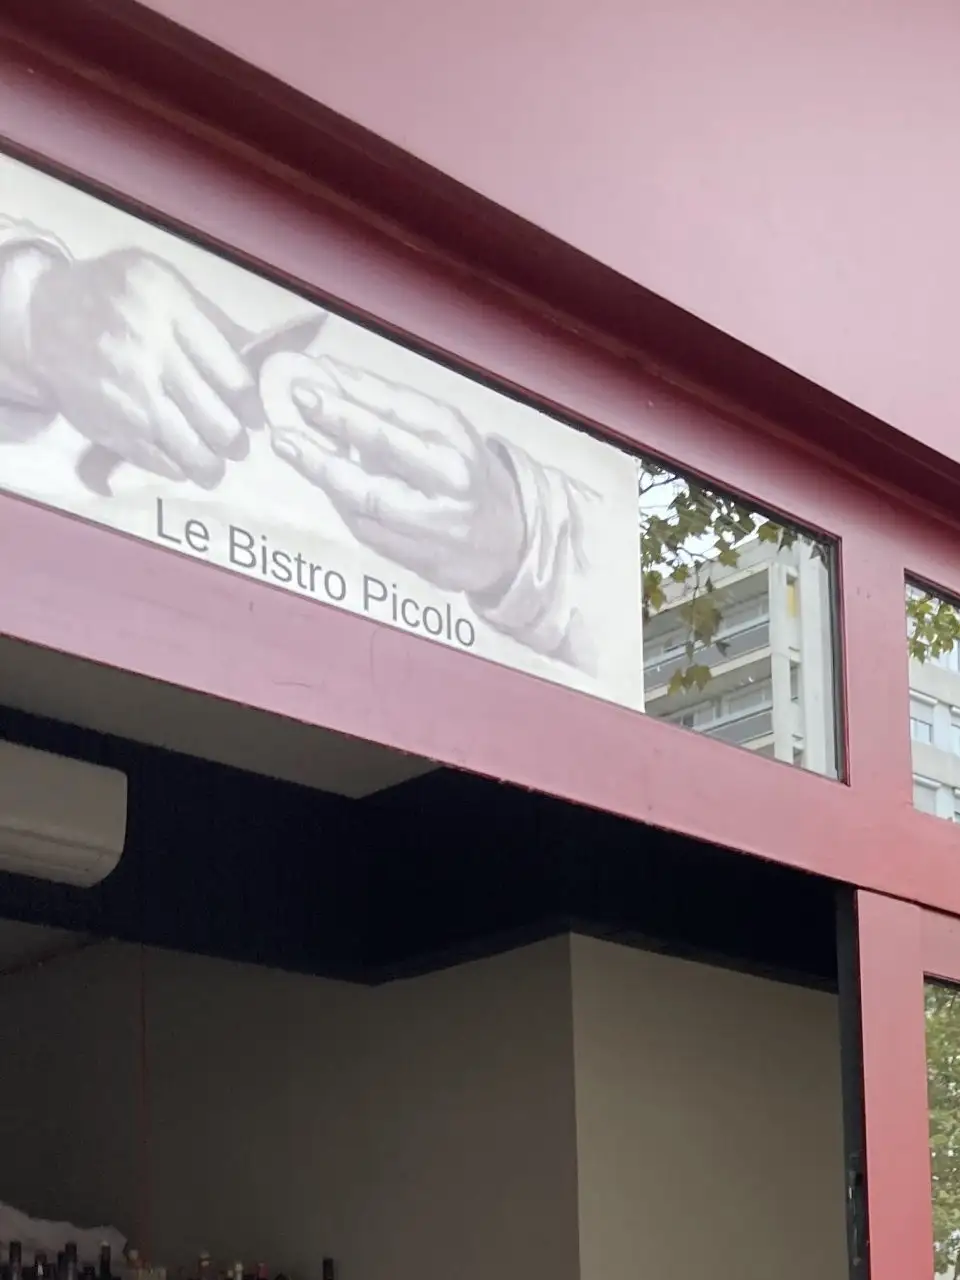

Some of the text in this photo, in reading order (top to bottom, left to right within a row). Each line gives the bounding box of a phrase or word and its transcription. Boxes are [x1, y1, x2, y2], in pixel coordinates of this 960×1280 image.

[156, 497, 477, 649] Le Bistro Picolo
